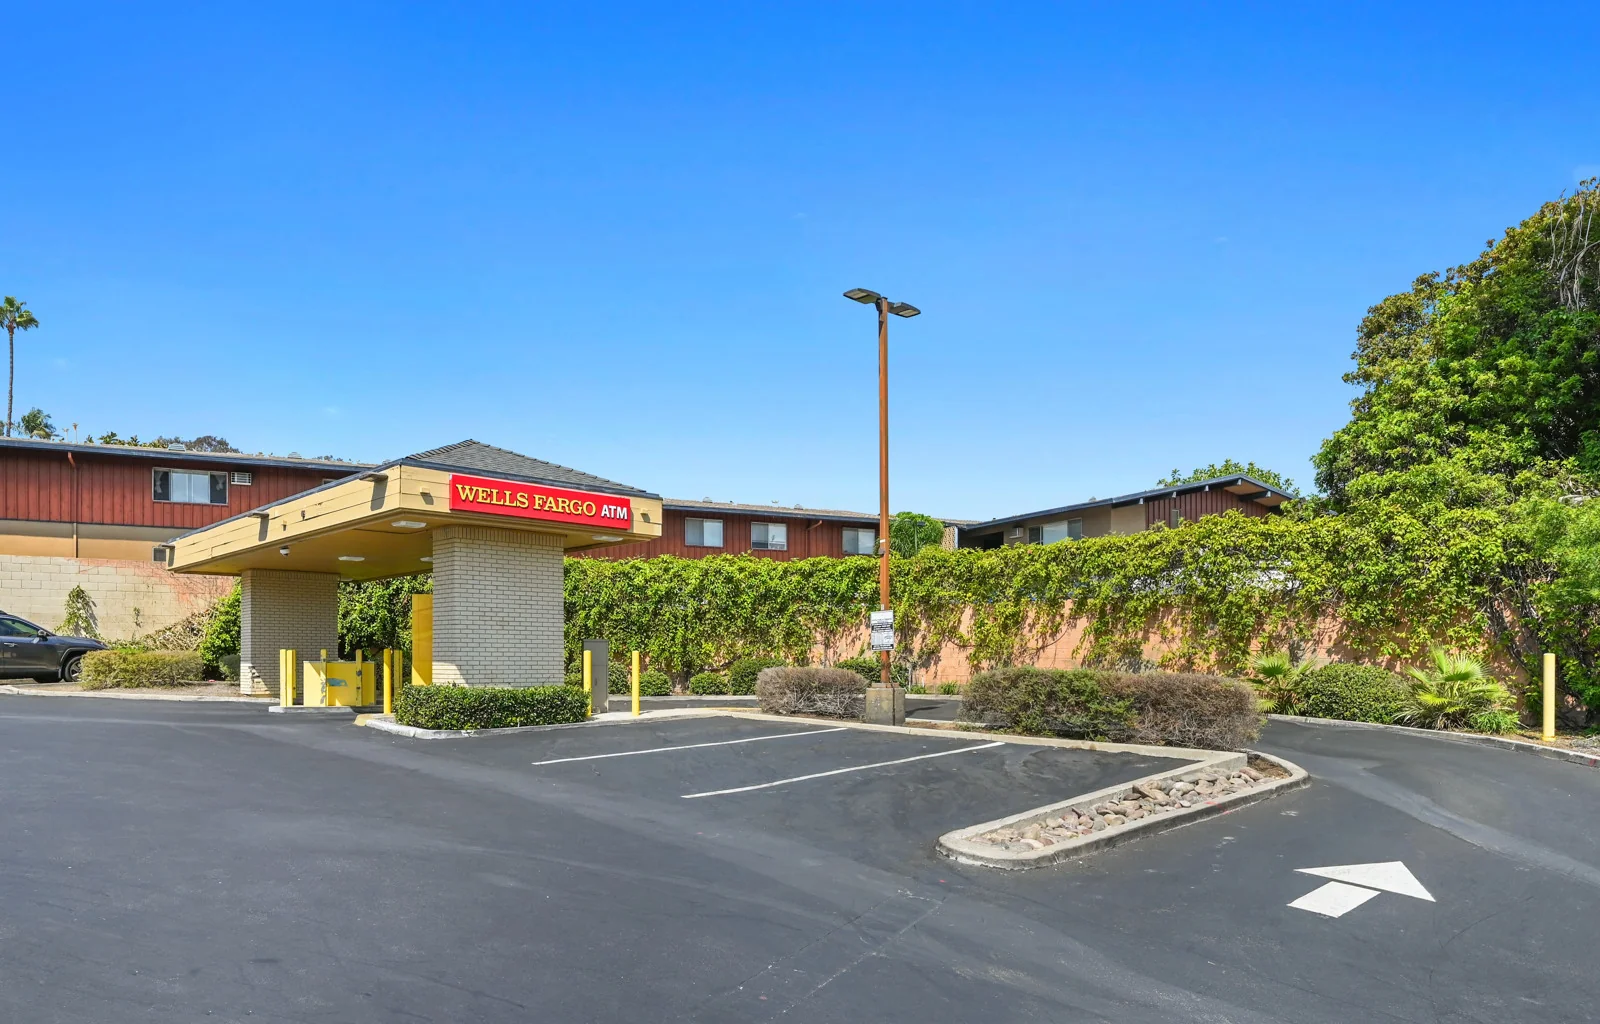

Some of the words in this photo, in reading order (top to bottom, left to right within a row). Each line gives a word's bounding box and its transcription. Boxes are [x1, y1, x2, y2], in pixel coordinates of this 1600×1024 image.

[456, 484, 529, 508] WELLS
[533, 494, 596, 517] FARGO
[601, 504, 628, 520] ATM
